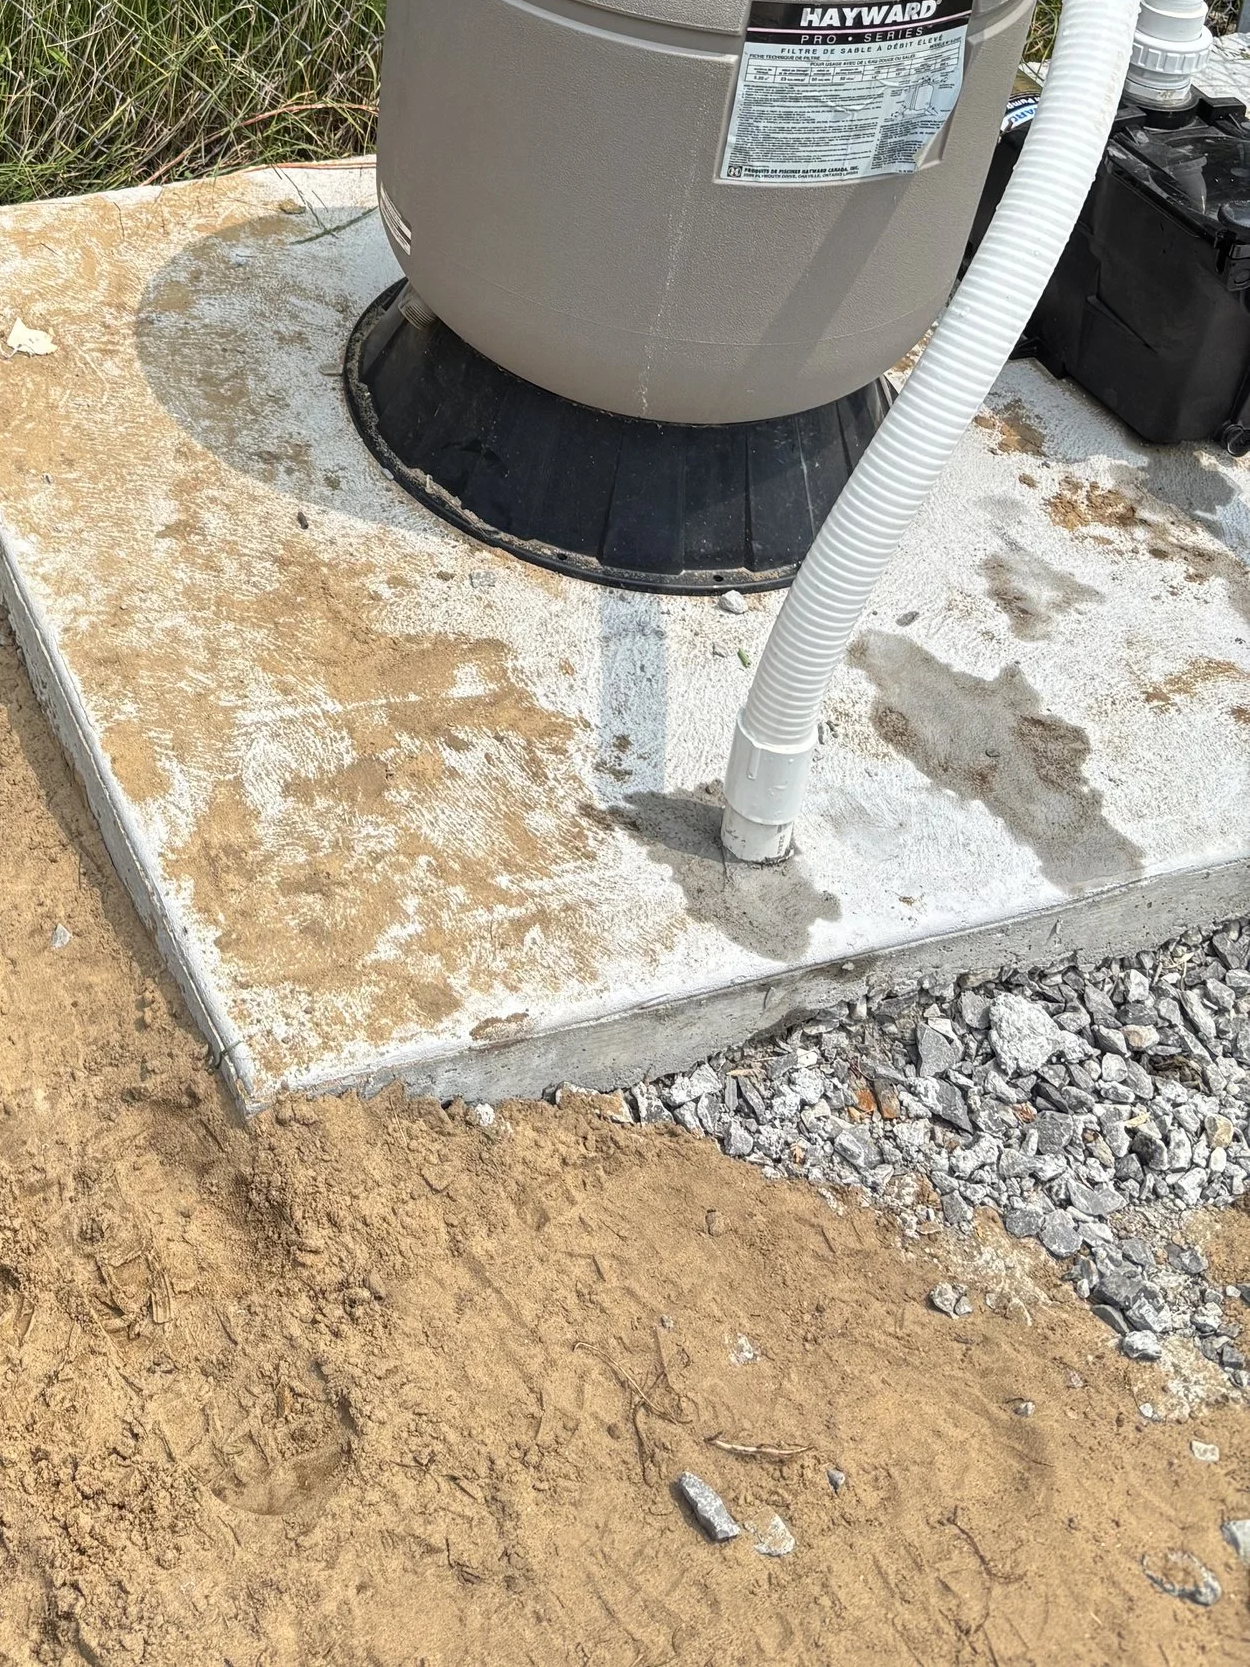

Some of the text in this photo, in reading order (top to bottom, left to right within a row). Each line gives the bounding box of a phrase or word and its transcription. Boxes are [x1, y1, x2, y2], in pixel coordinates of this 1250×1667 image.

[800, 0, 938, 27] HAYWARD
[800, 34, 837, 45] PRO
[863, 26, 923, 43] SERIES
[780, 47, 818, 55] FILTRE
[840, 46, 872, 54] SABLE
[886, 41, 914, 51] DÉBIT
